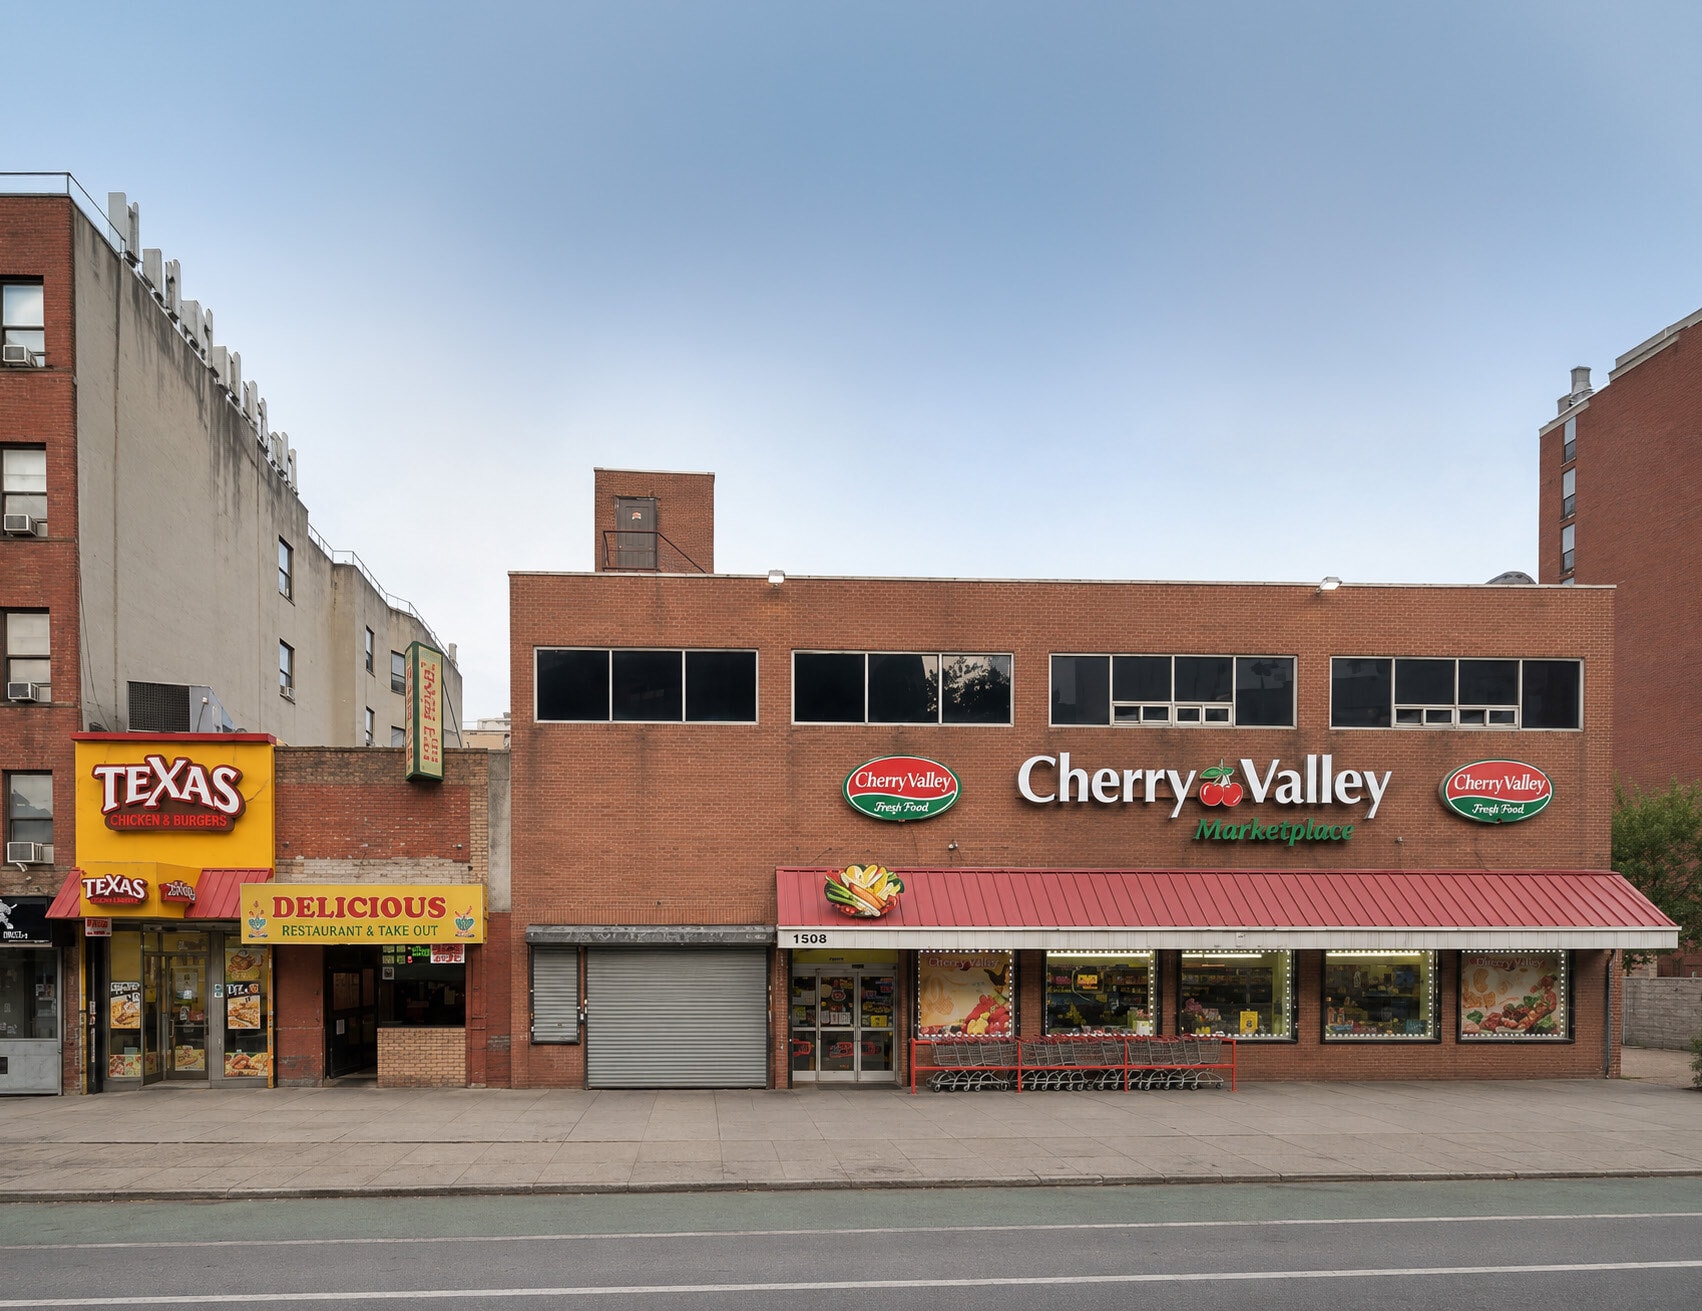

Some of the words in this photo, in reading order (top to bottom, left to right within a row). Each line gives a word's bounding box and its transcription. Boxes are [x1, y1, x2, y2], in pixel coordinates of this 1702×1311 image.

[93, 755, 242, 815] TEXAS
[855, 771, 907, 792] Cherry
[908, 772, 951, 793] Valley
[1018, 752, 1197, 819] Cherry
[1239, 754, 1393, 819] Valley
[1454, 774, 1504, 795] Cherry
[1504, 774, 1546, 795] Valley
[874, 801, 902, 815] Fresh
[903, 802, 929, 812] Food
[1472, 803, 1499, 816] Fresh
[1500, 803, 1525, 814] Food
[109, 814, 160, 827] CHICKEN
[162, 815, 170, 826] &
[173, 814, 228, 827] BURGERS
[1193, 817, 1355, 846] Marketplace
[81, 874, 146, 899] TEXAS
[272, 896, 447, 919] DELICIOUS
[282, 925, 363, 937] RESTAURANT
[366, 925, 375, 937] &
[378, 925, 410, 937] TAKE
[413, 925, 439, 937] OUT
[793, 934, 827, 944] 1508
